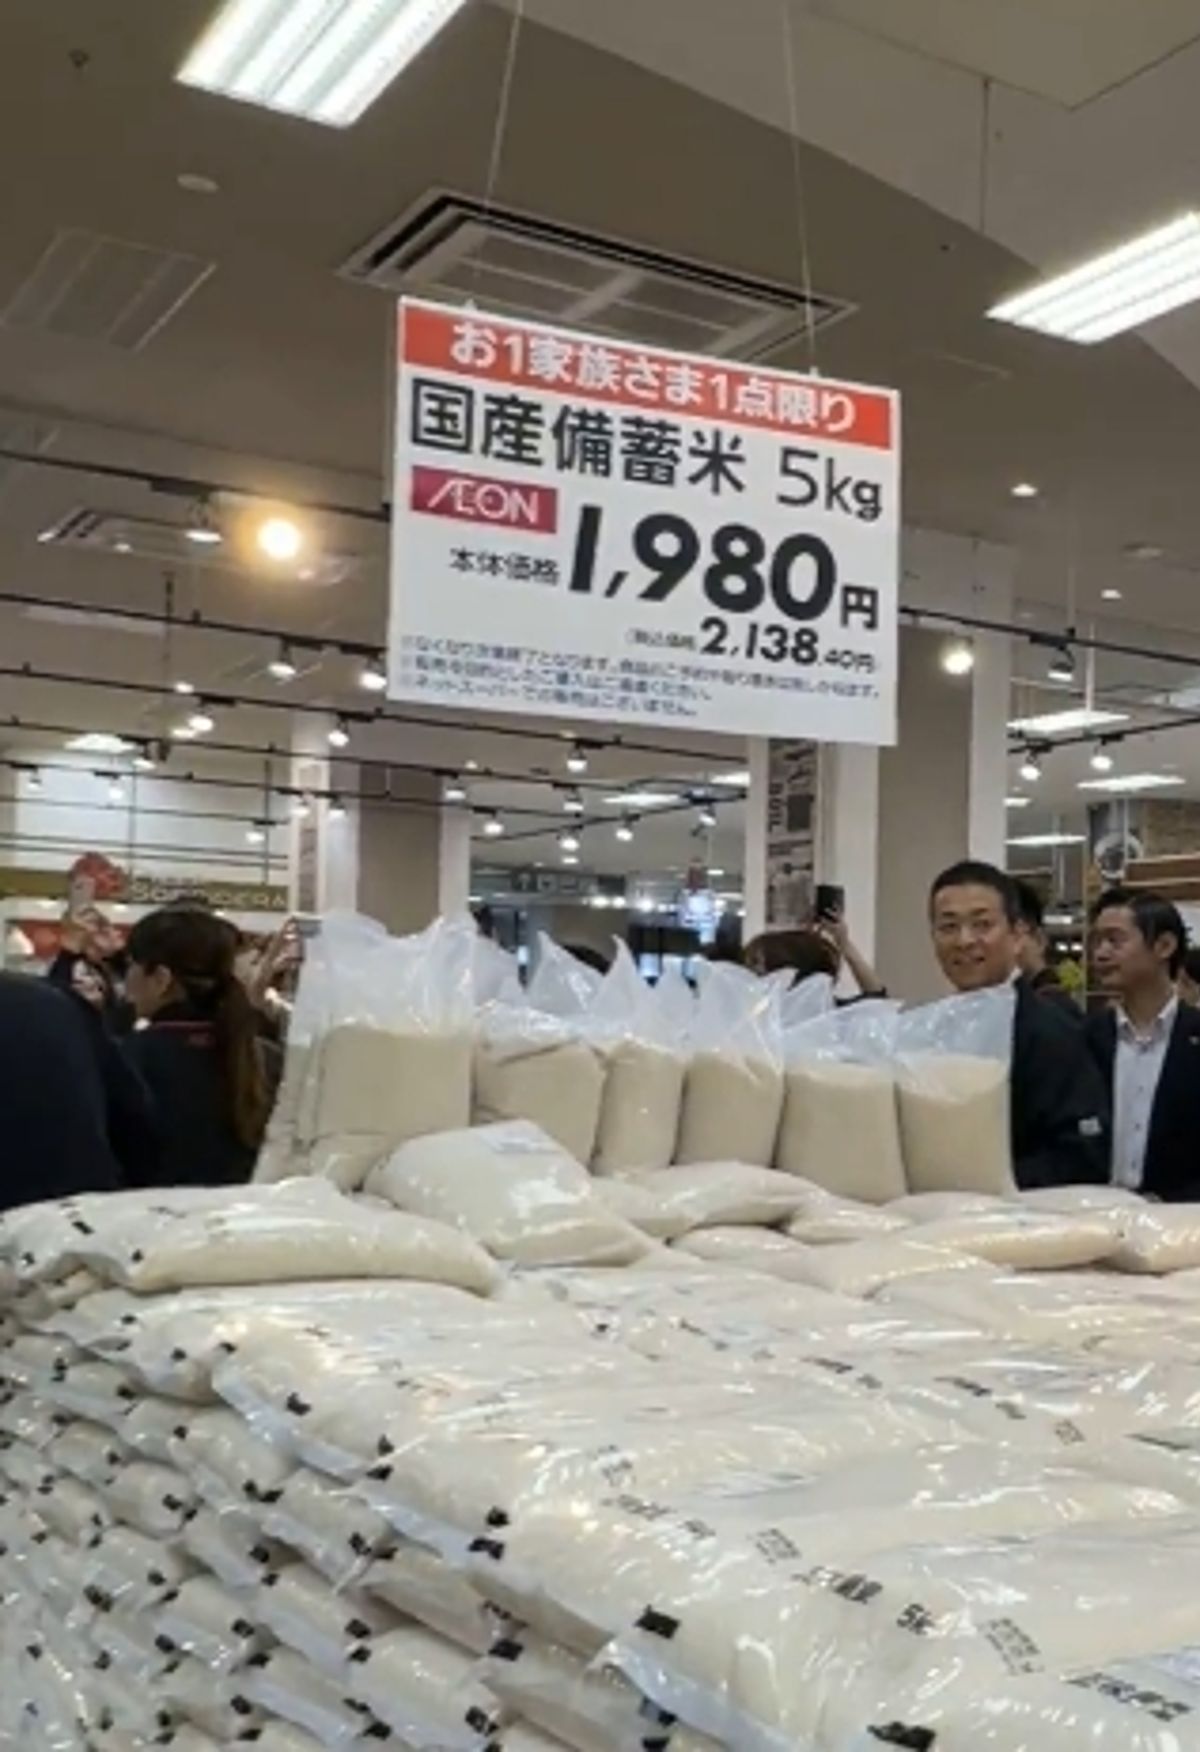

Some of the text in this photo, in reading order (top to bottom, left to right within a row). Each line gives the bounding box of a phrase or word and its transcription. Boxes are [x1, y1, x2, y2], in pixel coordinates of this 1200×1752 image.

[450, 321, 855, 433] お1家族さま1点限り
[411, 376, 883, 521] 国産備蓄米 5kg
